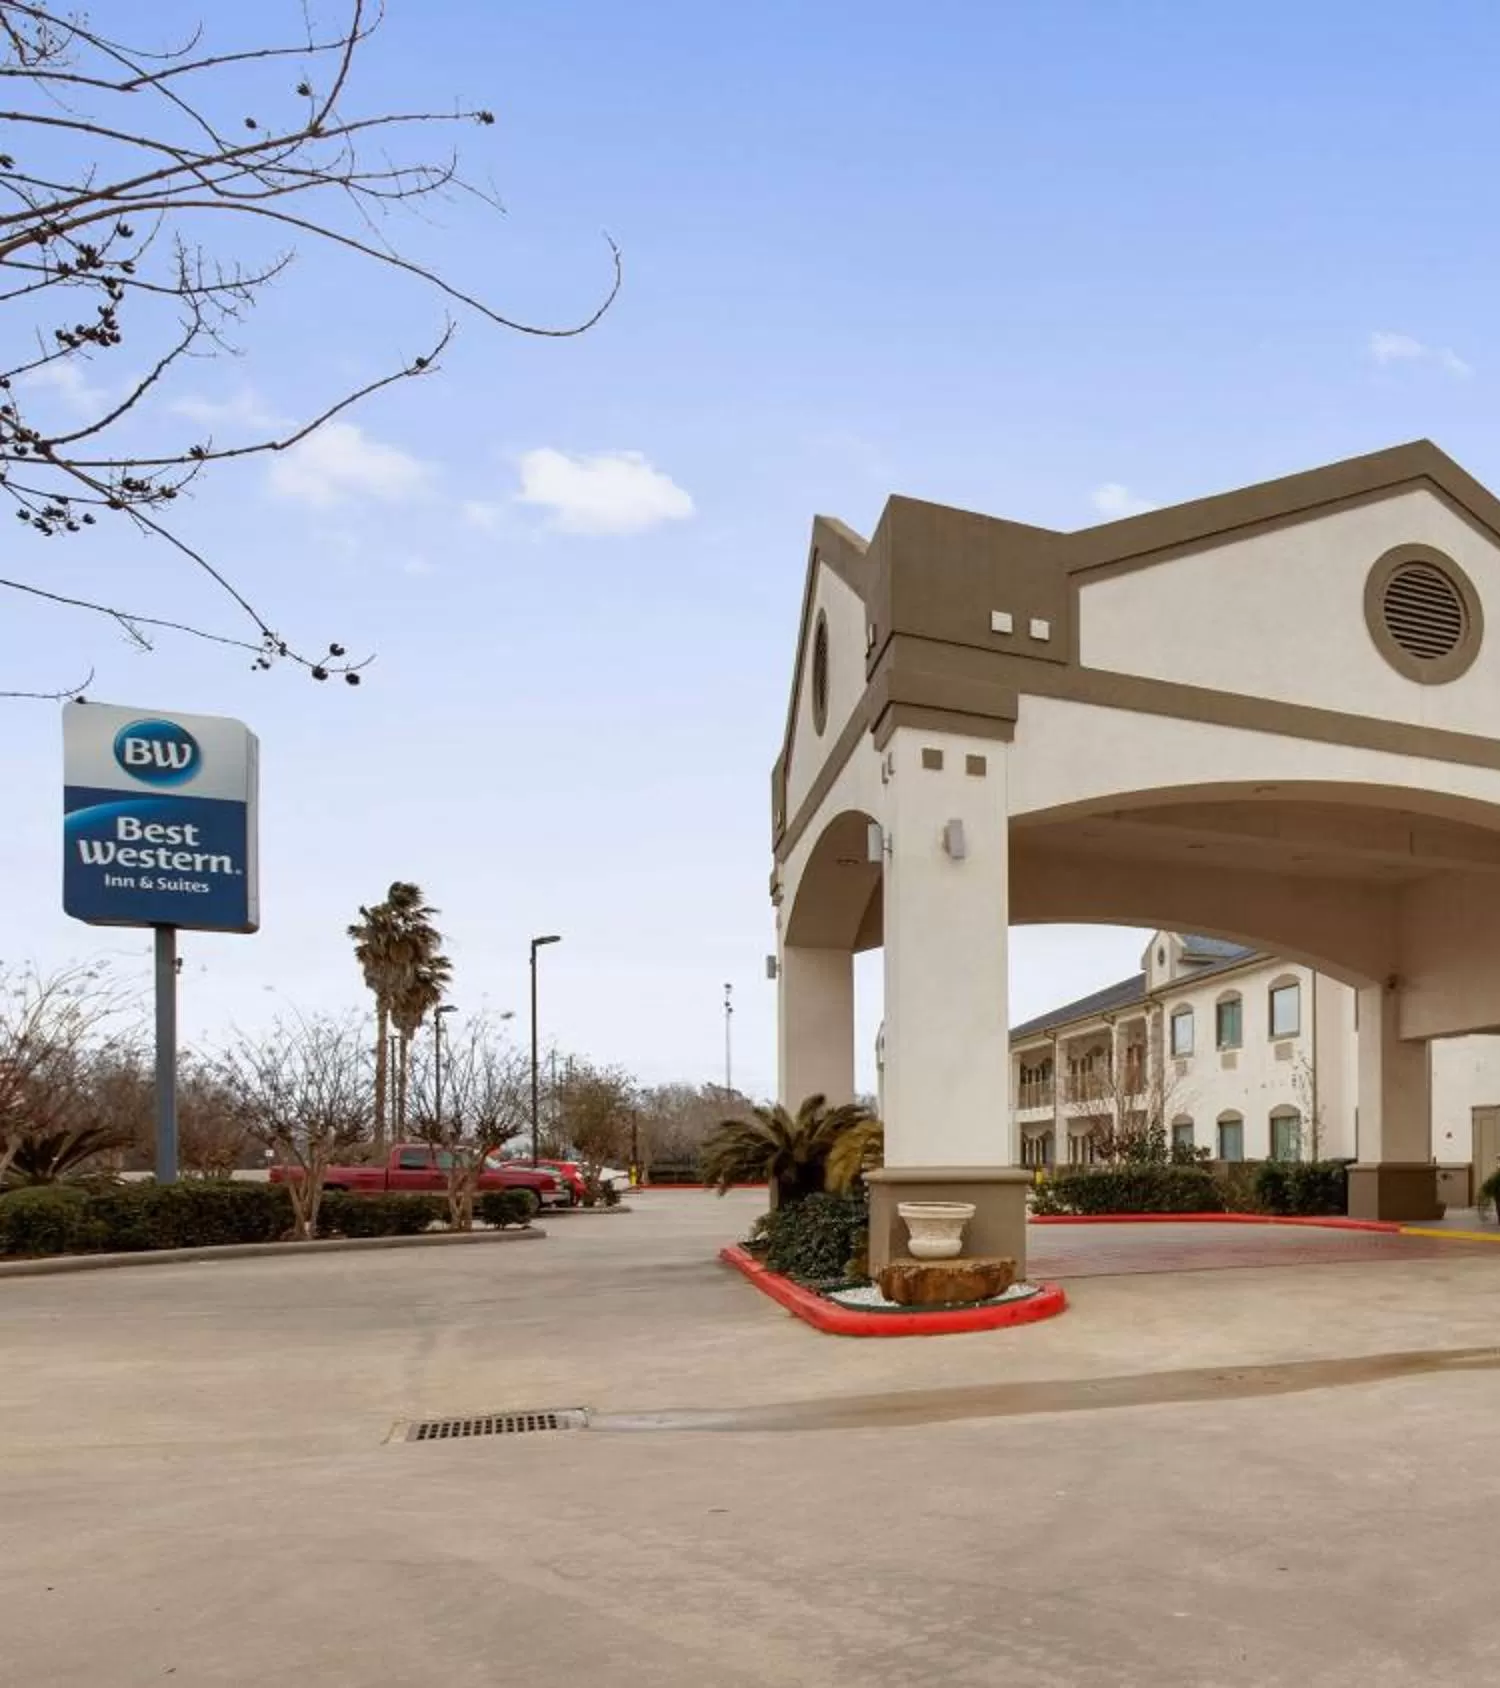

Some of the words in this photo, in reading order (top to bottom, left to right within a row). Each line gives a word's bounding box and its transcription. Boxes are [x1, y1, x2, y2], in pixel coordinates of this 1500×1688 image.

[124, 737, 192, 769] BW
[117, 816, 200, 846] Best
[104, 873, 135, 888] Inn
[139, 875, 154, 889] &
[157, 877, 210, 893] Suites
